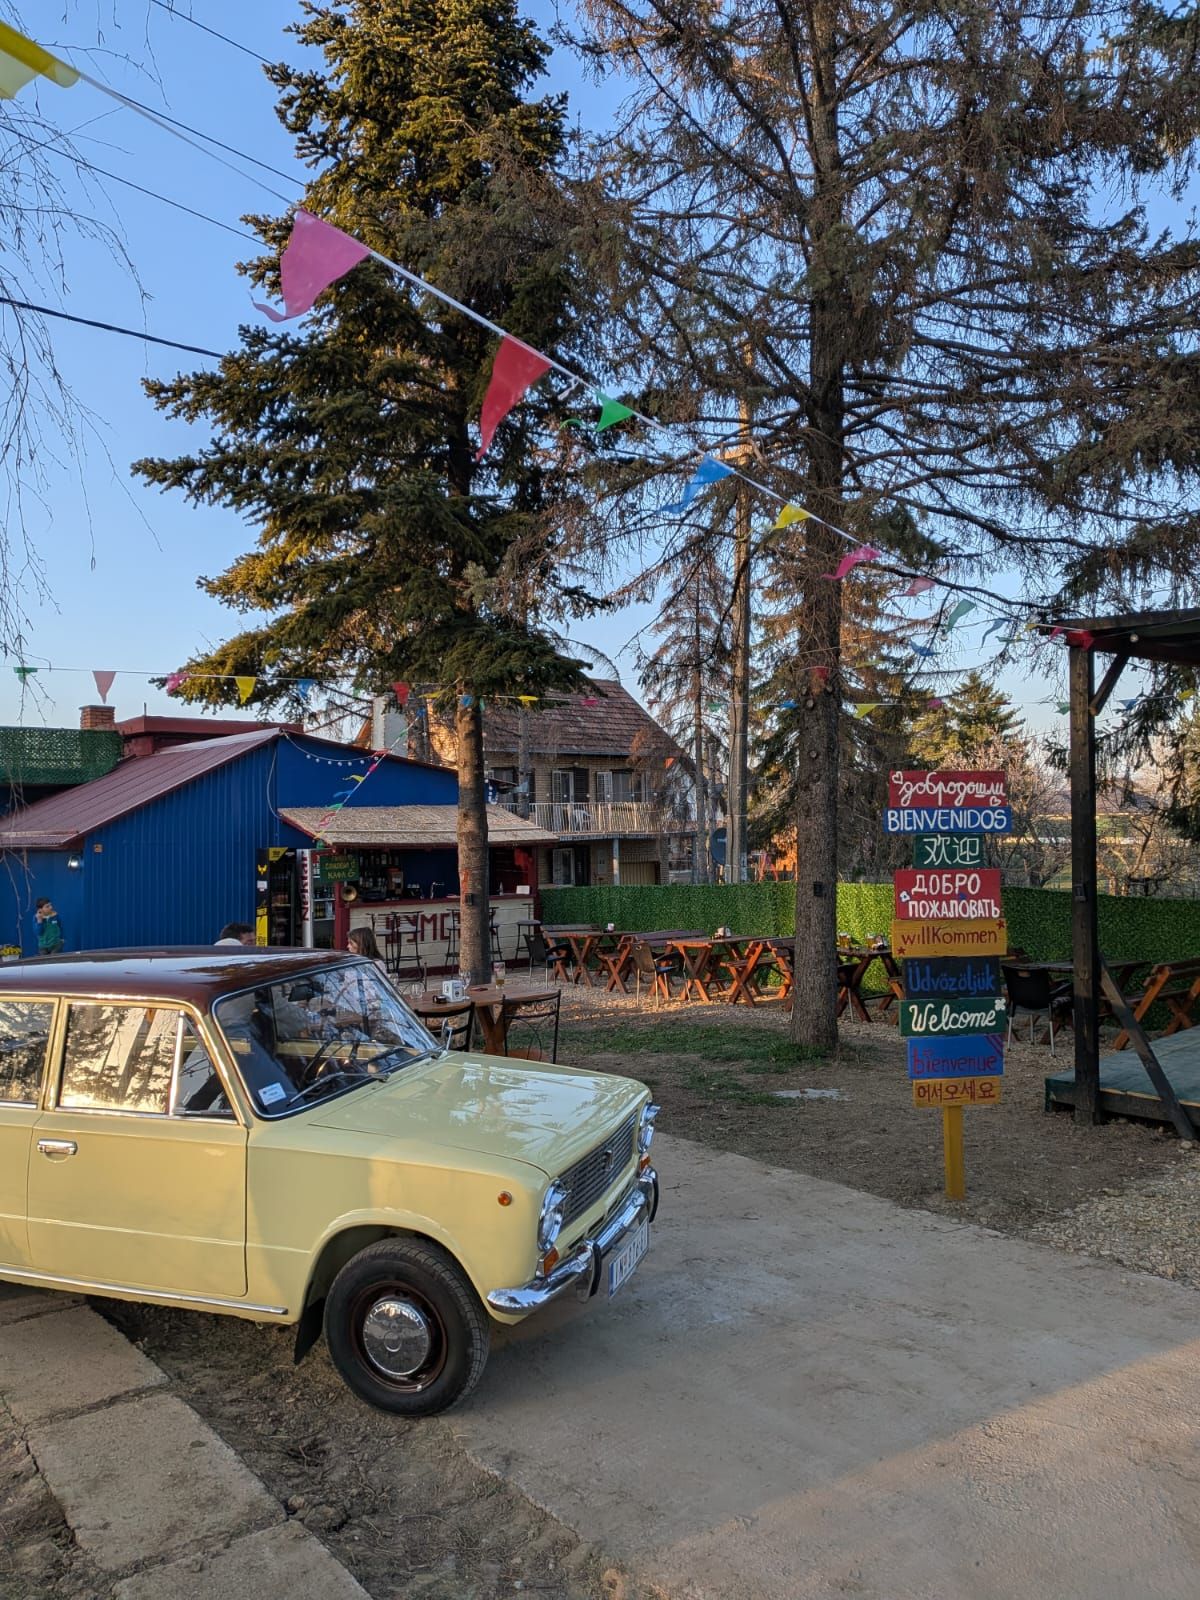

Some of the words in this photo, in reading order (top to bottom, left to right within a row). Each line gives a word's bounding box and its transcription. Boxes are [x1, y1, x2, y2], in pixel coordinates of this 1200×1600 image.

[899, 772, 1006, 806] добродошли
[887, 810, 1007, 831] BIENVENIDOS
[923, 835, 980, 865] 欢迎
[911, 873, 981, 895] ДОБРО
[908, 899, 1000, 918] ПОЖАЛОВАТЬ
[908, 961, 994, 994] Üdvözöljük
[909, 1004, 996, 1032] Welcome
[913, 1047, 997, 1073] bienvenue
